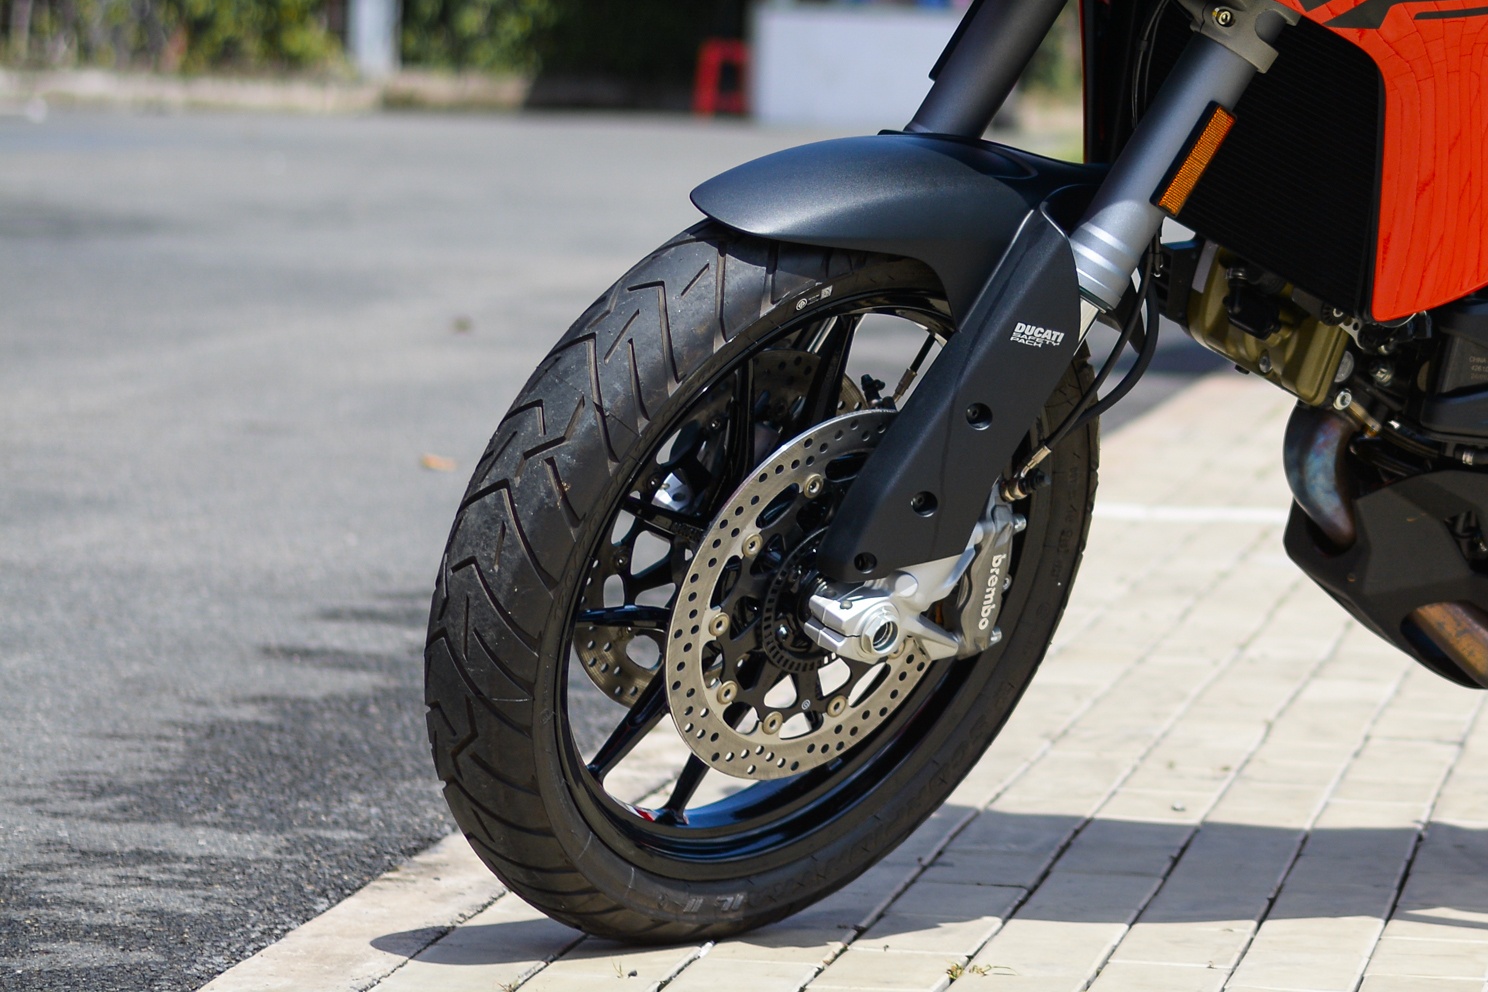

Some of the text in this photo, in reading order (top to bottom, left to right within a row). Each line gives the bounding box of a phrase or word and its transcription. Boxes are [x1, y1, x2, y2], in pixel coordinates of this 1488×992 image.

[1011, 331, 1060, 347] SAFETY
[1014, 322, 1064, 343] DUCATI
[1010, 336, 1042, 348] PACK
[978, 553, 1007, 630] brembo
